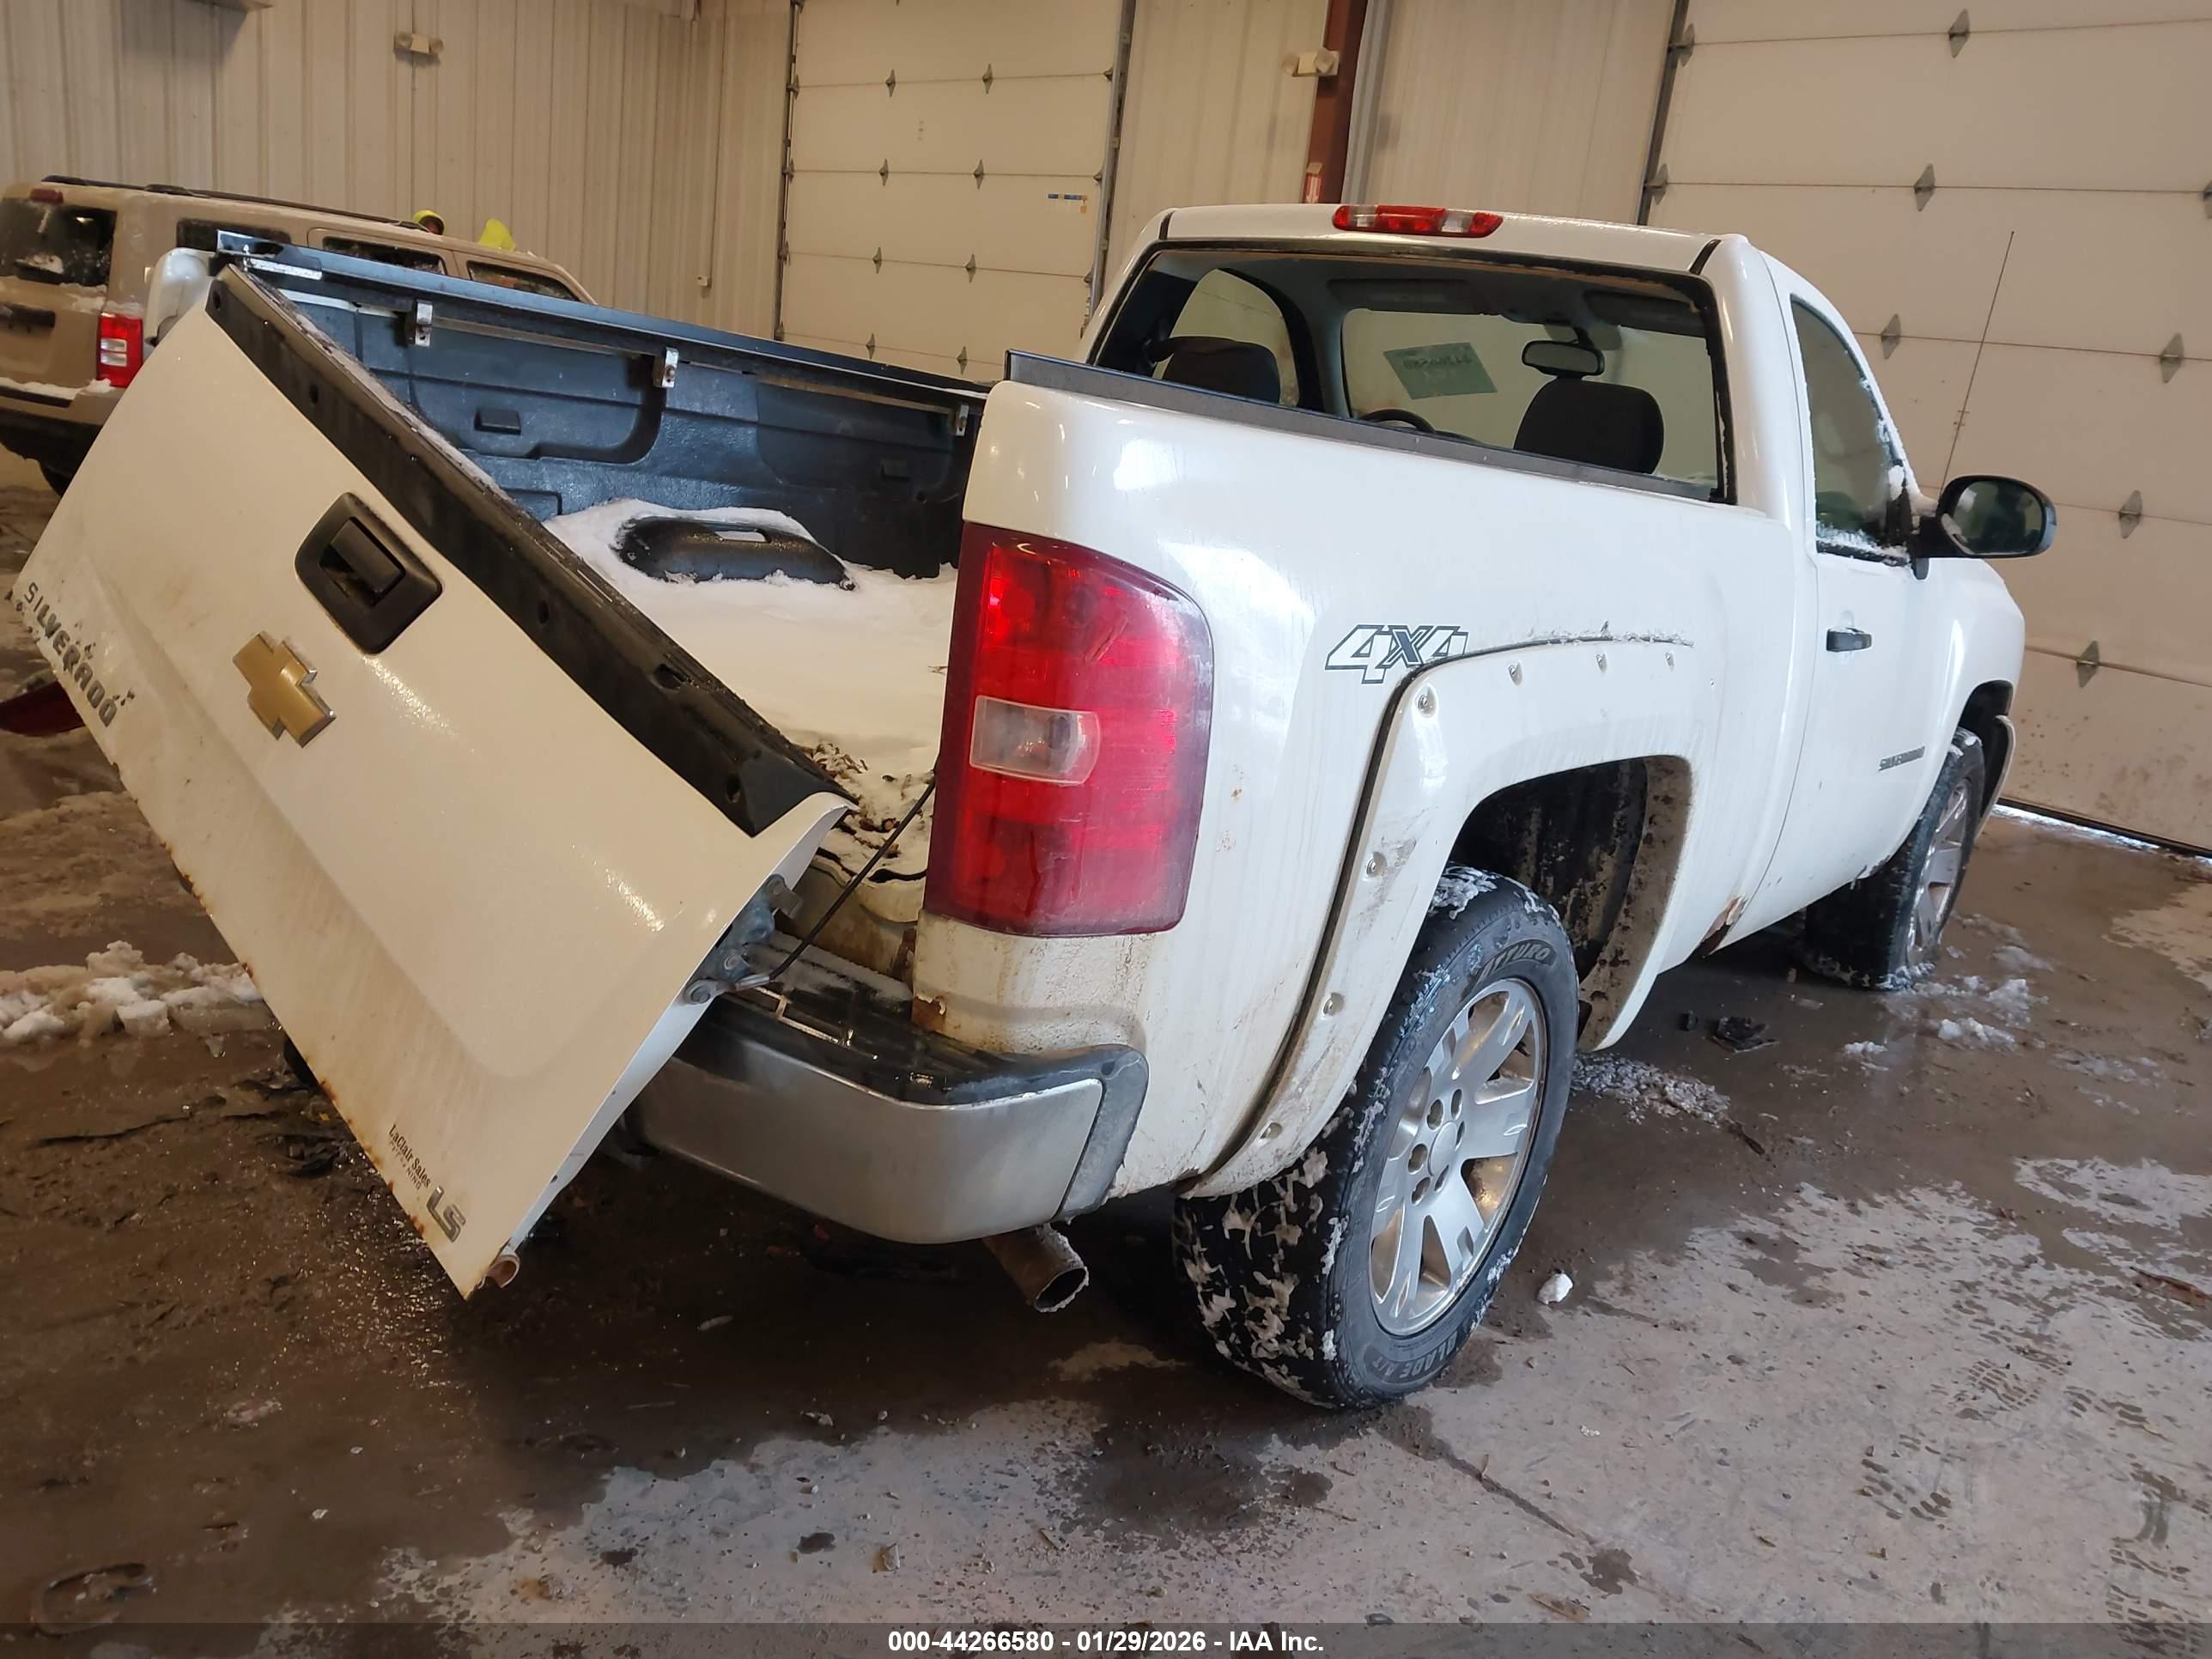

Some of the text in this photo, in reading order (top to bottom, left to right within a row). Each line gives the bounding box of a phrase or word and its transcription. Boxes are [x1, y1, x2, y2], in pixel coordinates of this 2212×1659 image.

[23, 581, 118, 727] SILVERADO
[388, 1123, 414, 1162] LaClair
[411, 1157, 431, 1188] Sales
[426, 1184, 467, 1243] LS
